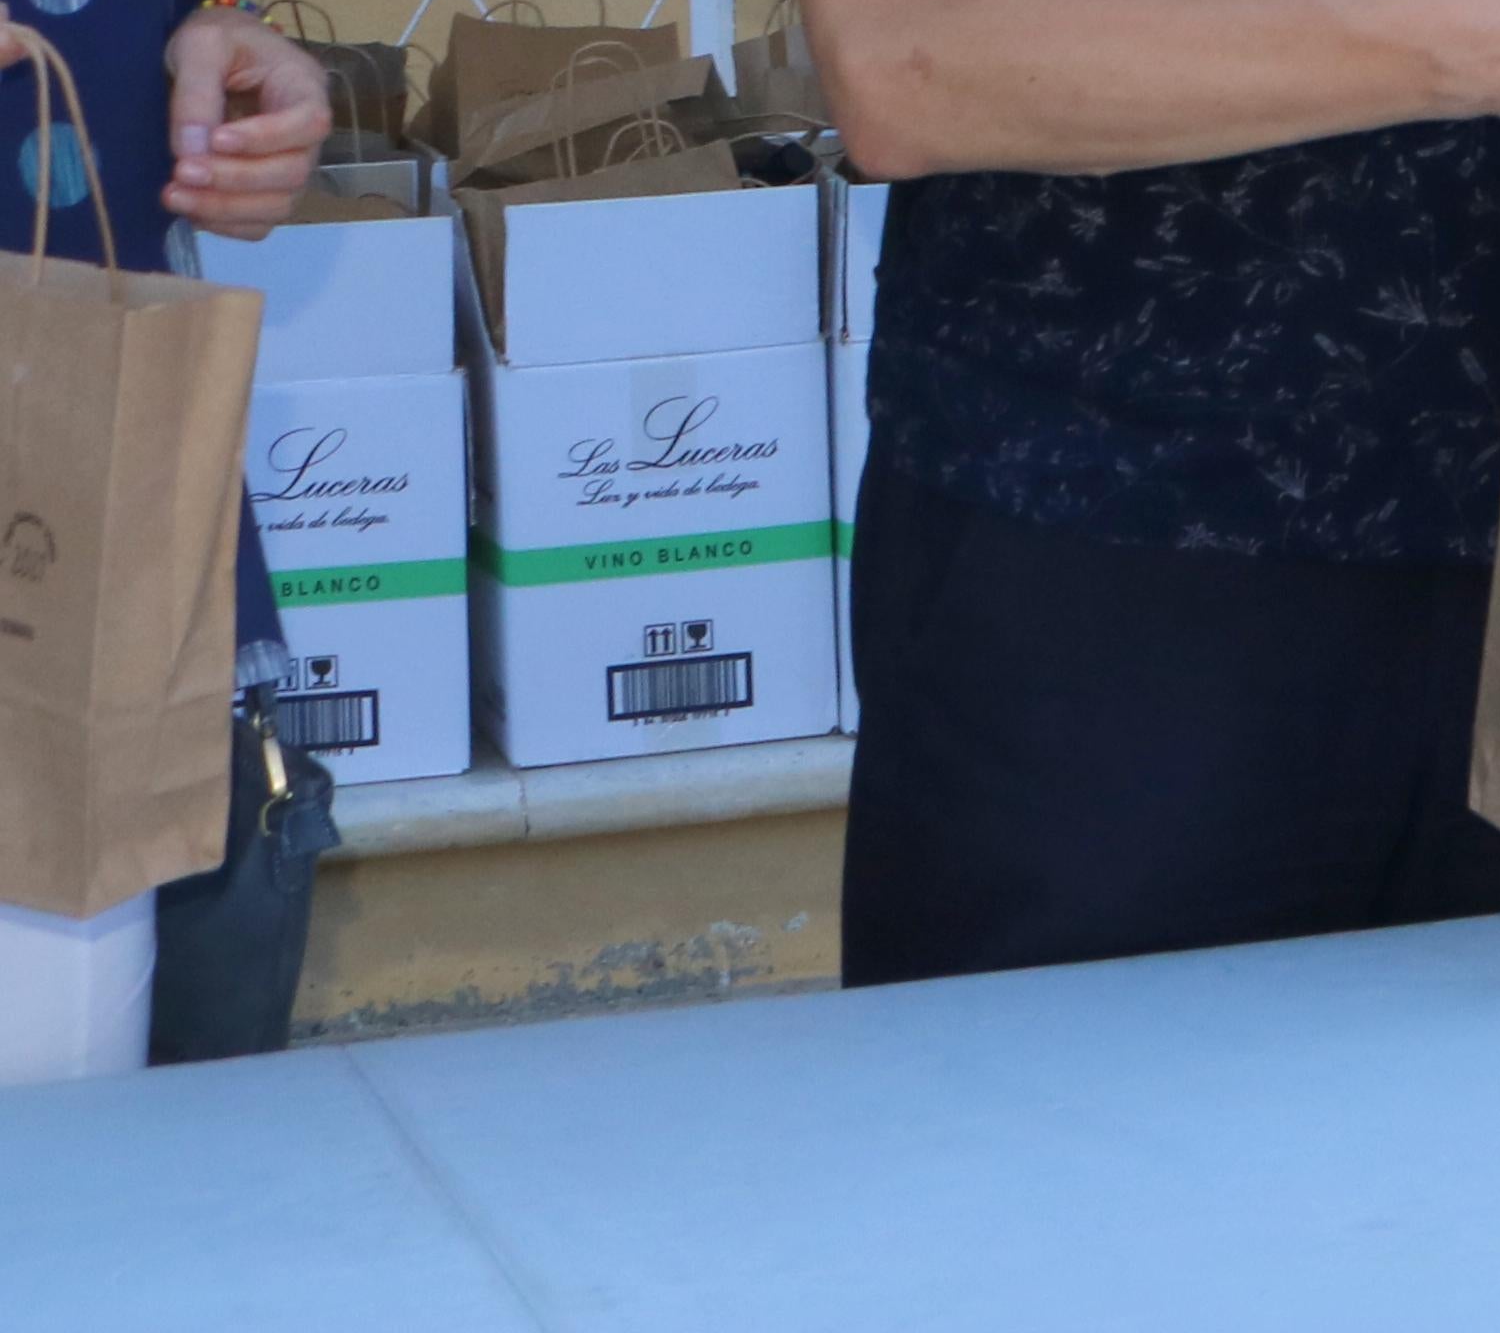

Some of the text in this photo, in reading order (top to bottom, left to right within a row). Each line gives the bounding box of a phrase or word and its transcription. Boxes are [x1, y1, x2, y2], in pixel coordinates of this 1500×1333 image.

[557, 395, 779, 479] Las Luceras
[250, 427, 409, 503] Luceras
[621, 492, 641, 509] y
[683, 478, 702, 497] de
[308, 511, 328, 529] de
[584, 540, 754, 570] VINO BLANCO
[281, 574, 381, 598] BLANCO
